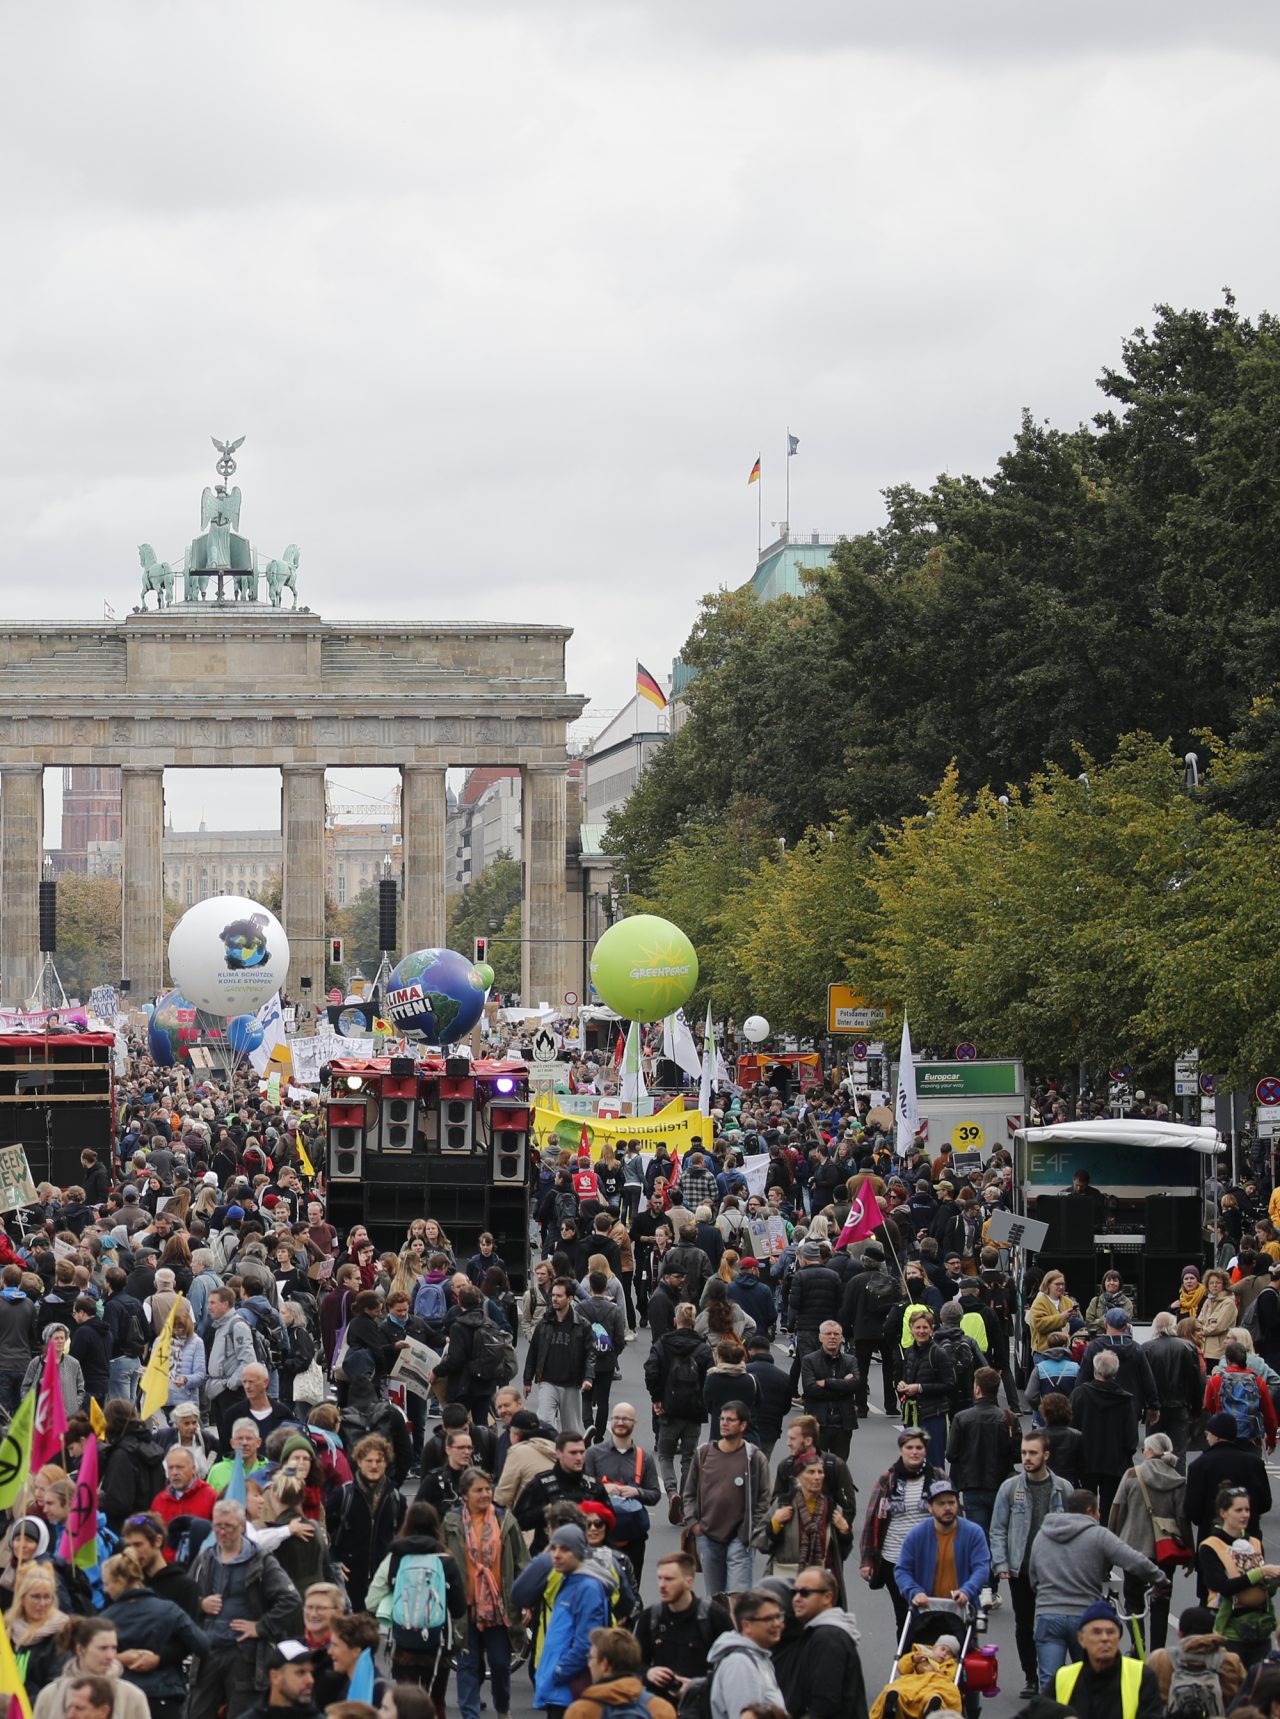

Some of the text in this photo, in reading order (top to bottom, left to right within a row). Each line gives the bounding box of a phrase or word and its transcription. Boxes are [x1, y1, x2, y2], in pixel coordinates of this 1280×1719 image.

[630, 964, 691, 979] GREENPEACE
[93, 1002, 118, 1017] BLOCK
[840, 1010, 885, 1018] Potsdamer Platz
[837, 1019, 851, 1027] Unter
[924, 1073, 960, 1081] Europcar
[959, 1127, 979, 1140] 39
